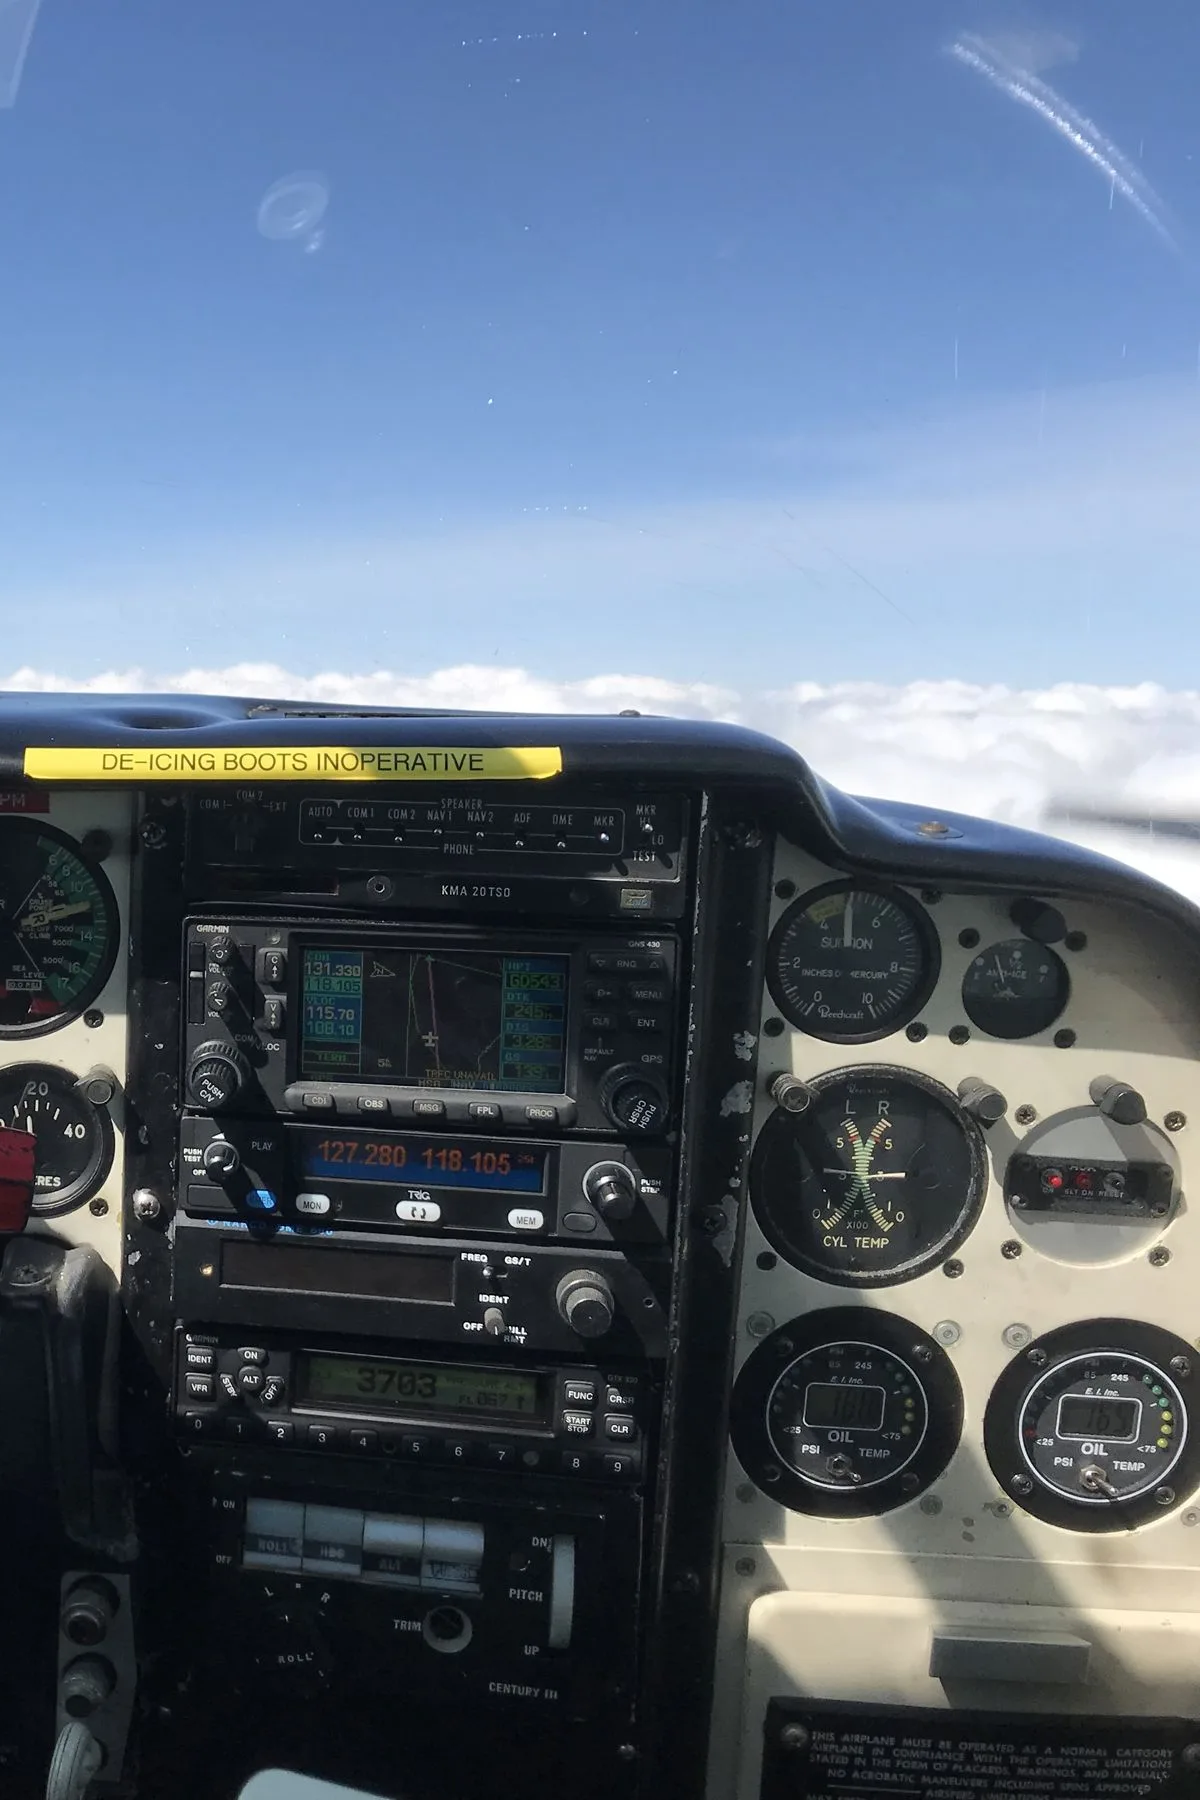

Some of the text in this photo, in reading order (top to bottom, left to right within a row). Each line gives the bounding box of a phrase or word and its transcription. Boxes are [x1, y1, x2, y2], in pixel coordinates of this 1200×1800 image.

[102, 752, 484, 772] DE-ICING BOOTS INOPERATIVE
[309, 807, 332, 817] AUTO
[444, 844, 655, 862] PHONE TEST
[442, 886, 467, 896] KMA
[196, 925, 229, 934] GARMIN
[311, 1096, 327, 1104] CDI
[364, 1100, 383, 1108] OBS
[477, 1106, 552, 1117] FPL PROC
[251, 1141, 272, 1150] PLAY
[319, 1140, 406, 1167] 127.280
[423, 1148, 511, 1175] 118.105
[303, 1201, 321, 1210] MON
[517, 1216, 536, 1225] MEM
[824, 1236, 889, 1248] CYL TEMP
[461, 1253, 531, 1266] FREQ GS/T
[479, 1294, 509, 1304] IDENT
[463, 1323, 483, 1331] OFF
[188, 1354, 211, 1363] IDENT
[244, 1351, 257, 1359] ON
[243, 1376, 259, 1384] ALT
[358, 1368, 437, 1397] 3703
[1111, 1374, 1128, 1382] 245
[191, 1384, 208, 1392] VFR
[568, 1391, 593, 1400] FUNC
[566, 1417, 590, 1425] START
[567, 1425, 588, 1433] STOP
[611, 1425, 628, 1434] CLR
[828, 1431, 853, 1443] OIL
[802, 1445, 820, 1454] PSI
[859, 1448, 890, 1458] TEMP
[1081, 1443, 1108, 1456] OIL
[1054, 1457, 1072, 1466] PSI
[1113, 1461, 1145, 1471] TEMP
[509, 1589, 543, 1601] PITCH
[393, 1619, 421, 1631] TRIM
[489, 1682, 540, 1697] CENTURY
[812, 1731, 834, 1742] THIS
[842, 1734, 895, 1747] AIRPLANE
[902, 1738, 932, 1748] MUST
[1116, 1748, 1173, 1758] CATEGORY
[810, 1742, 865, 1755] AIRPLANE
[974, 1753, 1002, 1763] WITH
[1009, 1755, 1029, 1764] THE
[872, 1758, 891, 1767] THE
[896, 1760, 928, 1770] FORM
[852, 1770, 915, 1783] ACROBATIC
